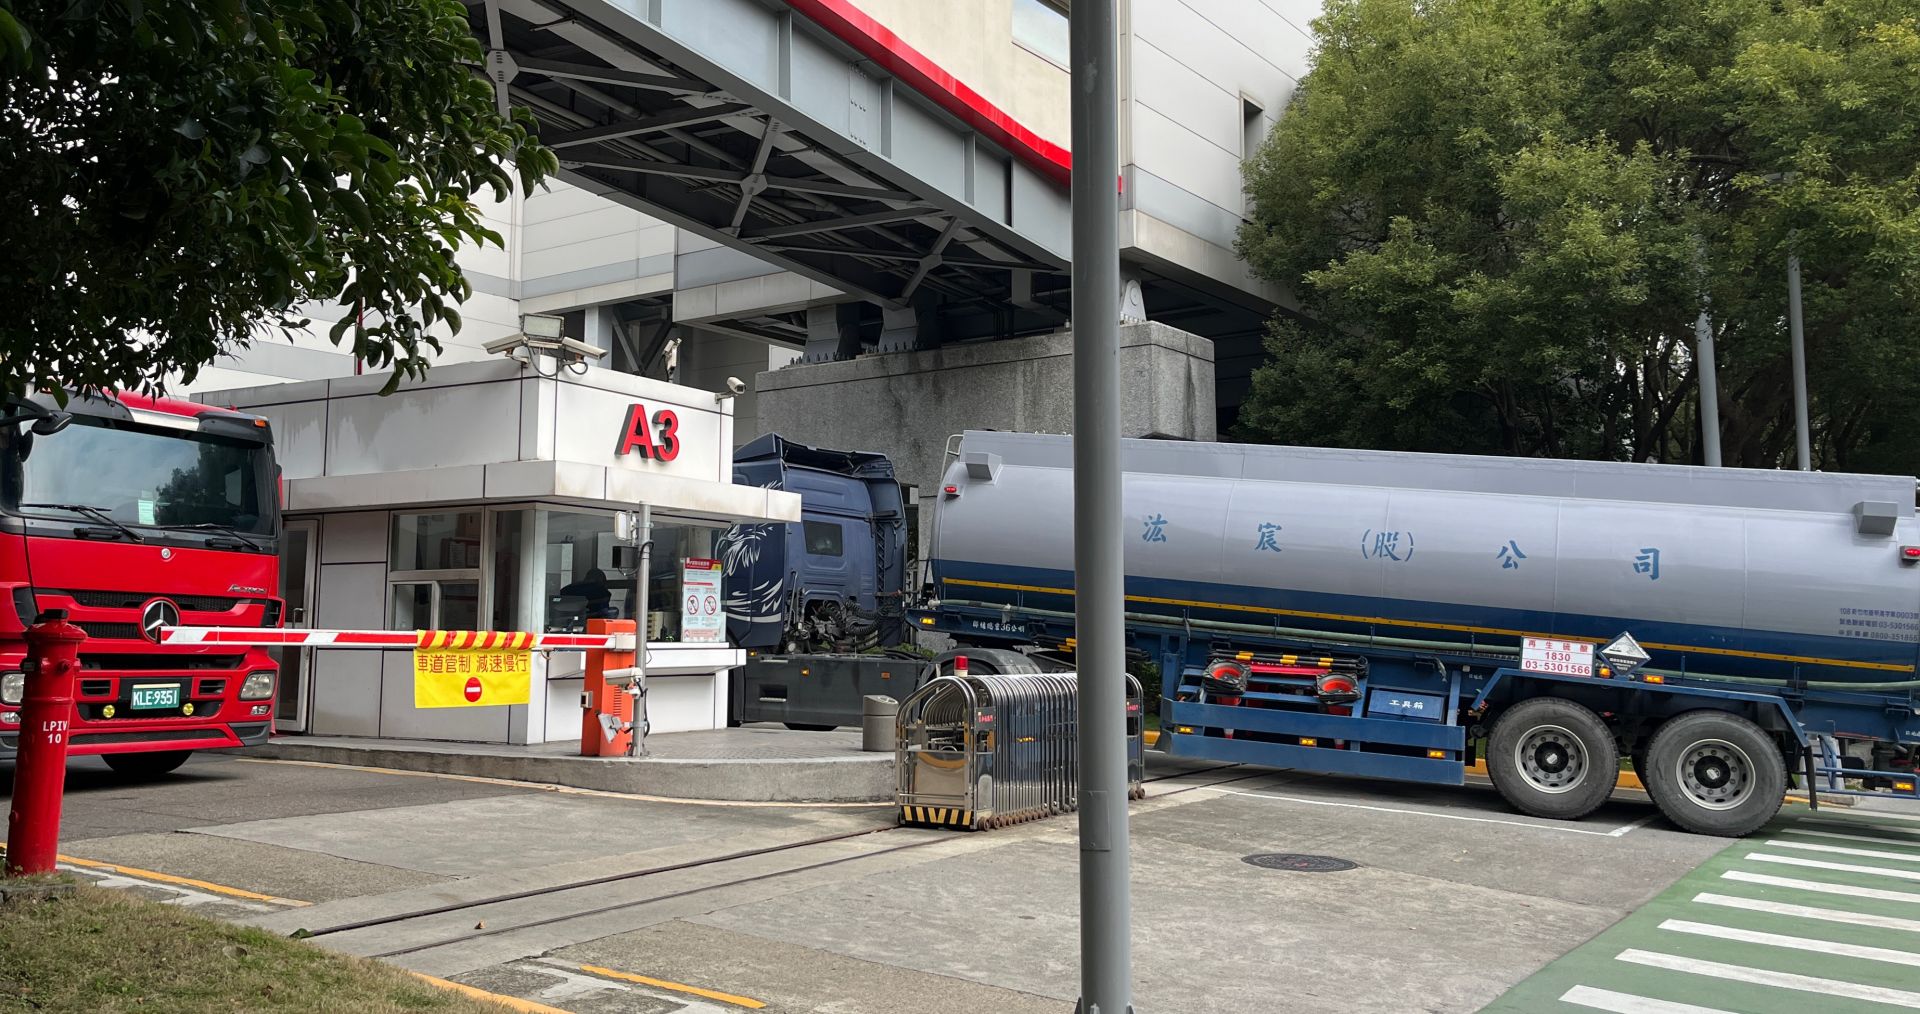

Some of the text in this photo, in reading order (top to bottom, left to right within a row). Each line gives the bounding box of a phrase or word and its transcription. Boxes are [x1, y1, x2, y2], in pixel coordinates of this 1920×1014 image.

[614, 404, 679, 462] A3
[1545, 652, 1571, 662] 1830
[417, 654, 528, 673] 車道管制 減速慢行
[1525, 660, 1590, 674] 03-5301566
[133, 690, 178, 706] KLE-9351
[1389, 700, 1424, 710] 工具箱
[43, 721, 68, 732] LPIV
[48, 734, 62, 744] 10
